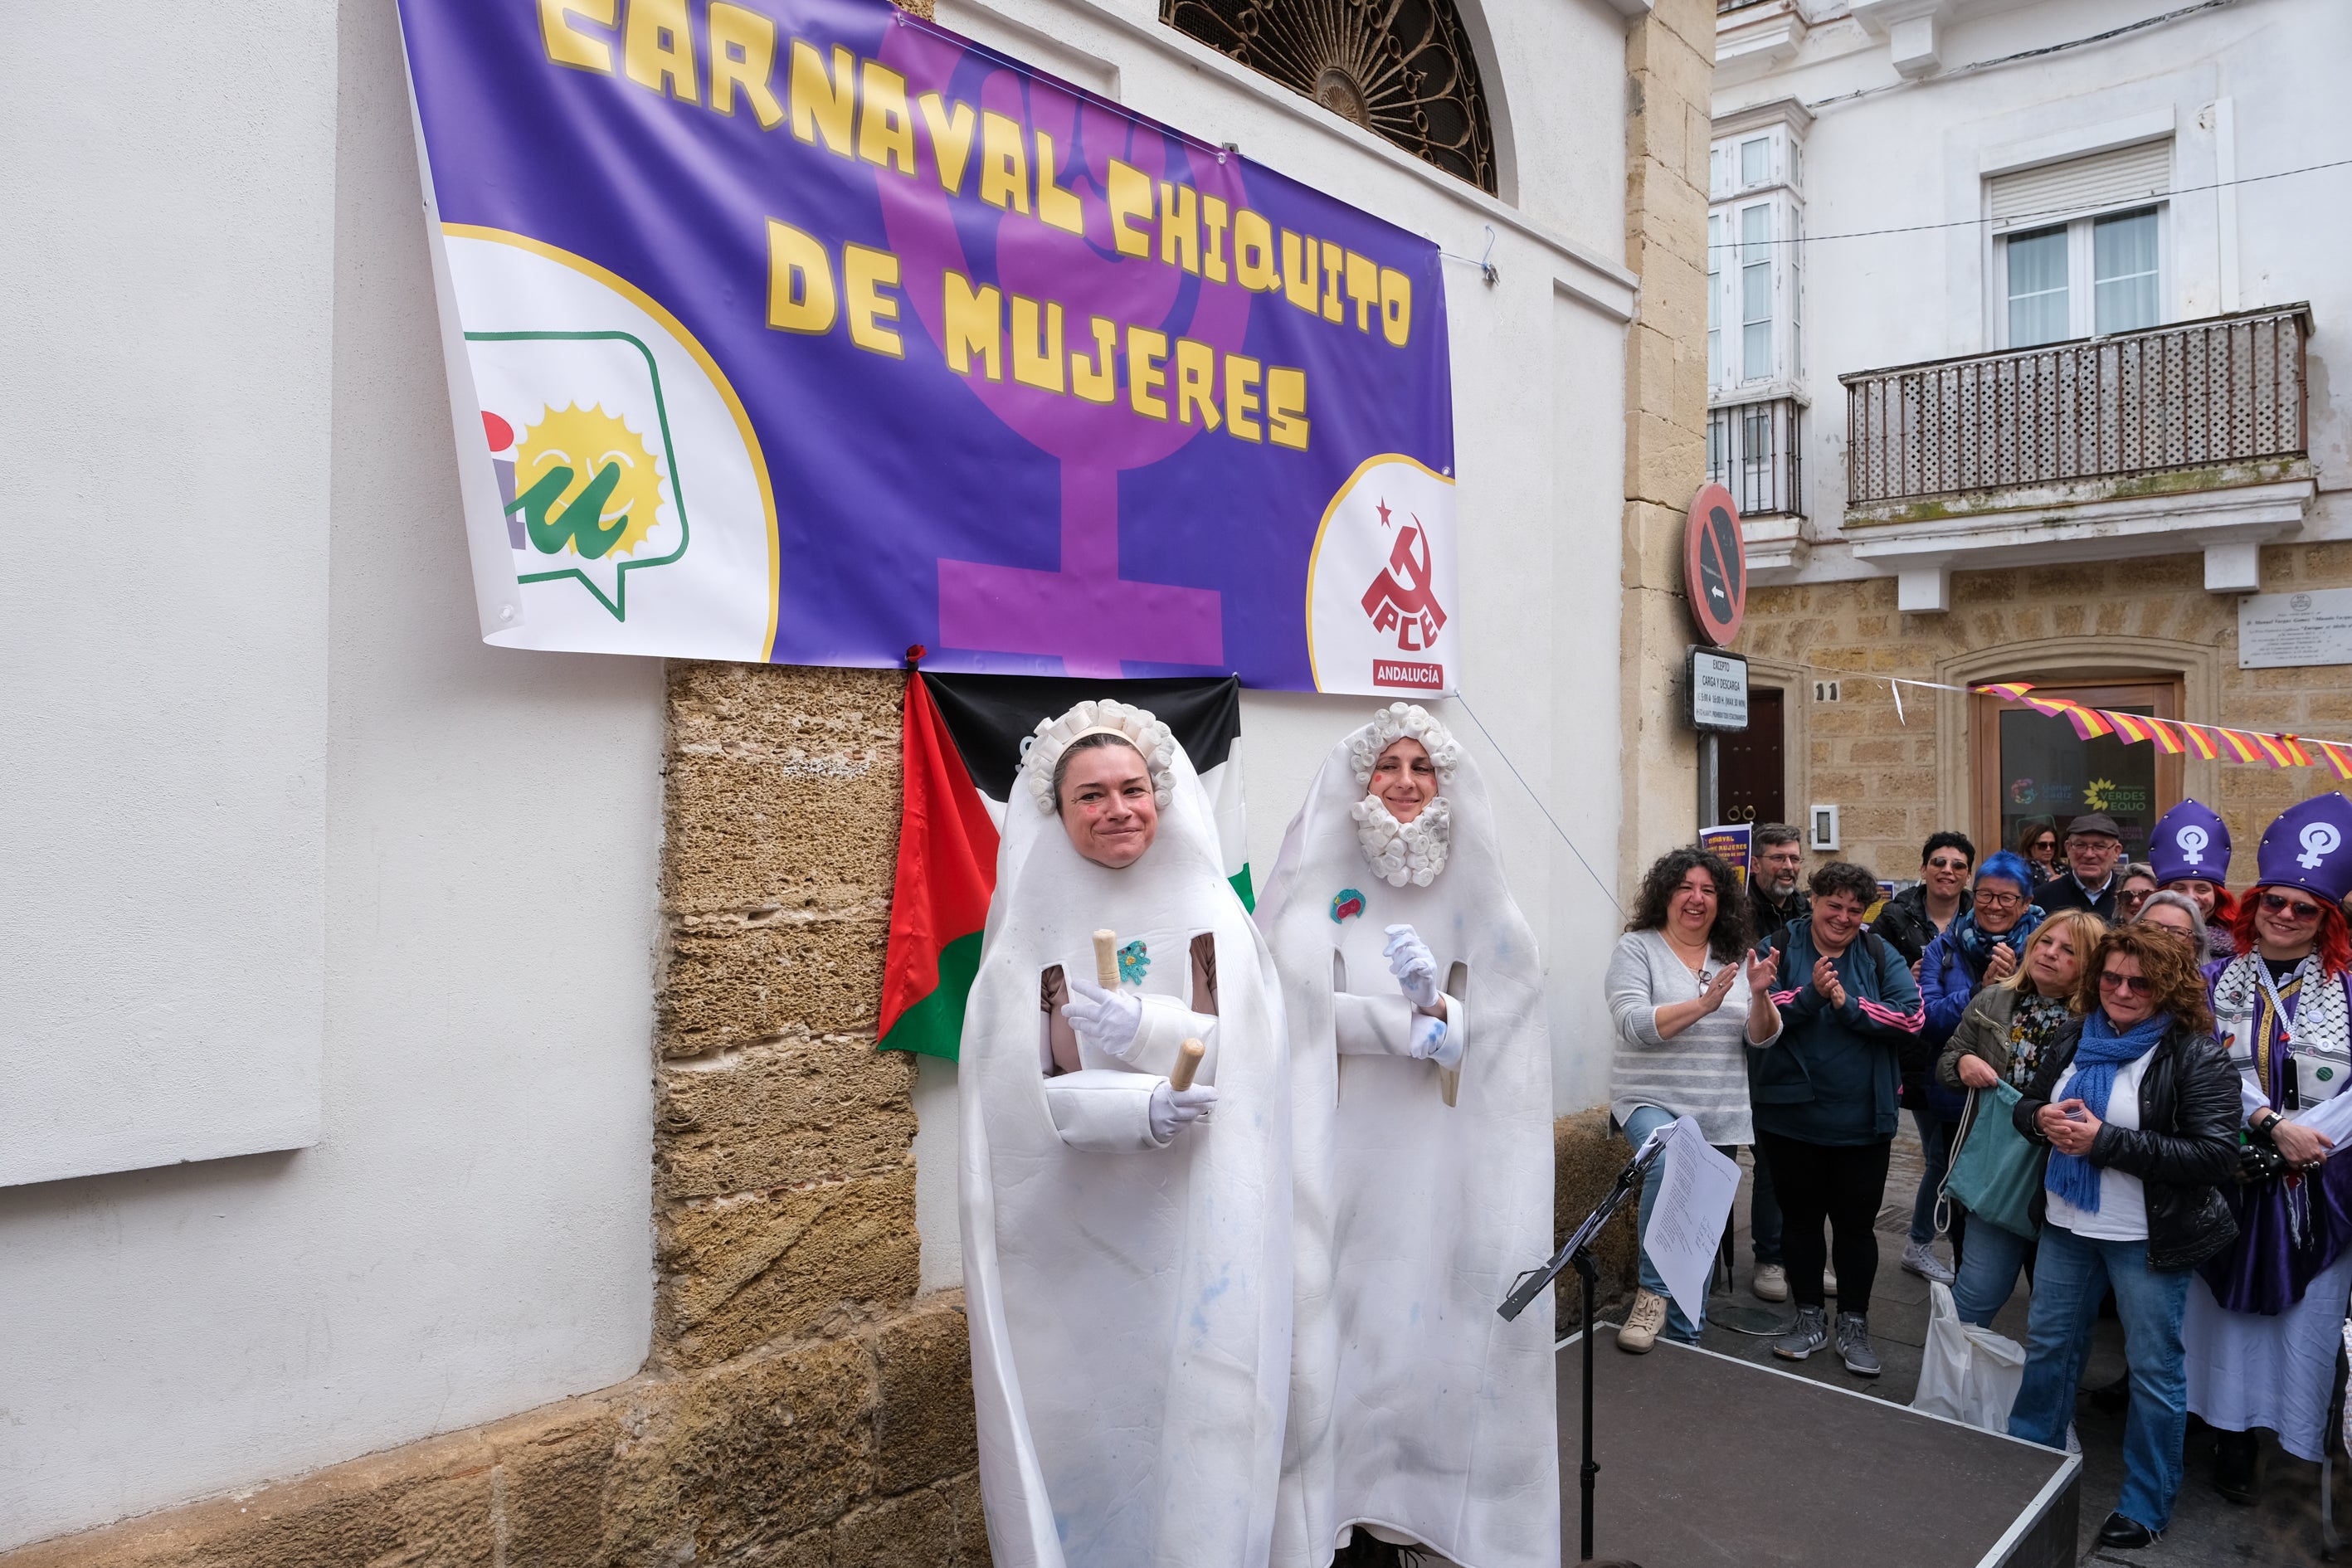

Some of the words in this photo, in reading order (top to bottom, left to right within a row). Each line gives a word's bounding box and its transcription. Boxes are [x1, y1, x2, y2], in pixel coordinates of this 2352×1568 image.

[535, 0, 1085, 238] CARNAVAL
[1106, 155, 1413, 348] CHIQUITO
[764, 215, 906, 361] DE
[942, 268, 1311, 452] MUJERES
[1372, 600, 1439, 652] PCE
[1377, 665, 1439, 684] ANDALUCÍA
[1712, 660, 1730, 672] EXCEPTO
[1702, 675, 1716, 688] CARGA
[1717, 678, 1720, 688] Y
[1720, 678, 1741, 691] DESCARGA
[2100, 791, 2146, 801] VERDES
[2110, 802, 2146, 811] EQUO
